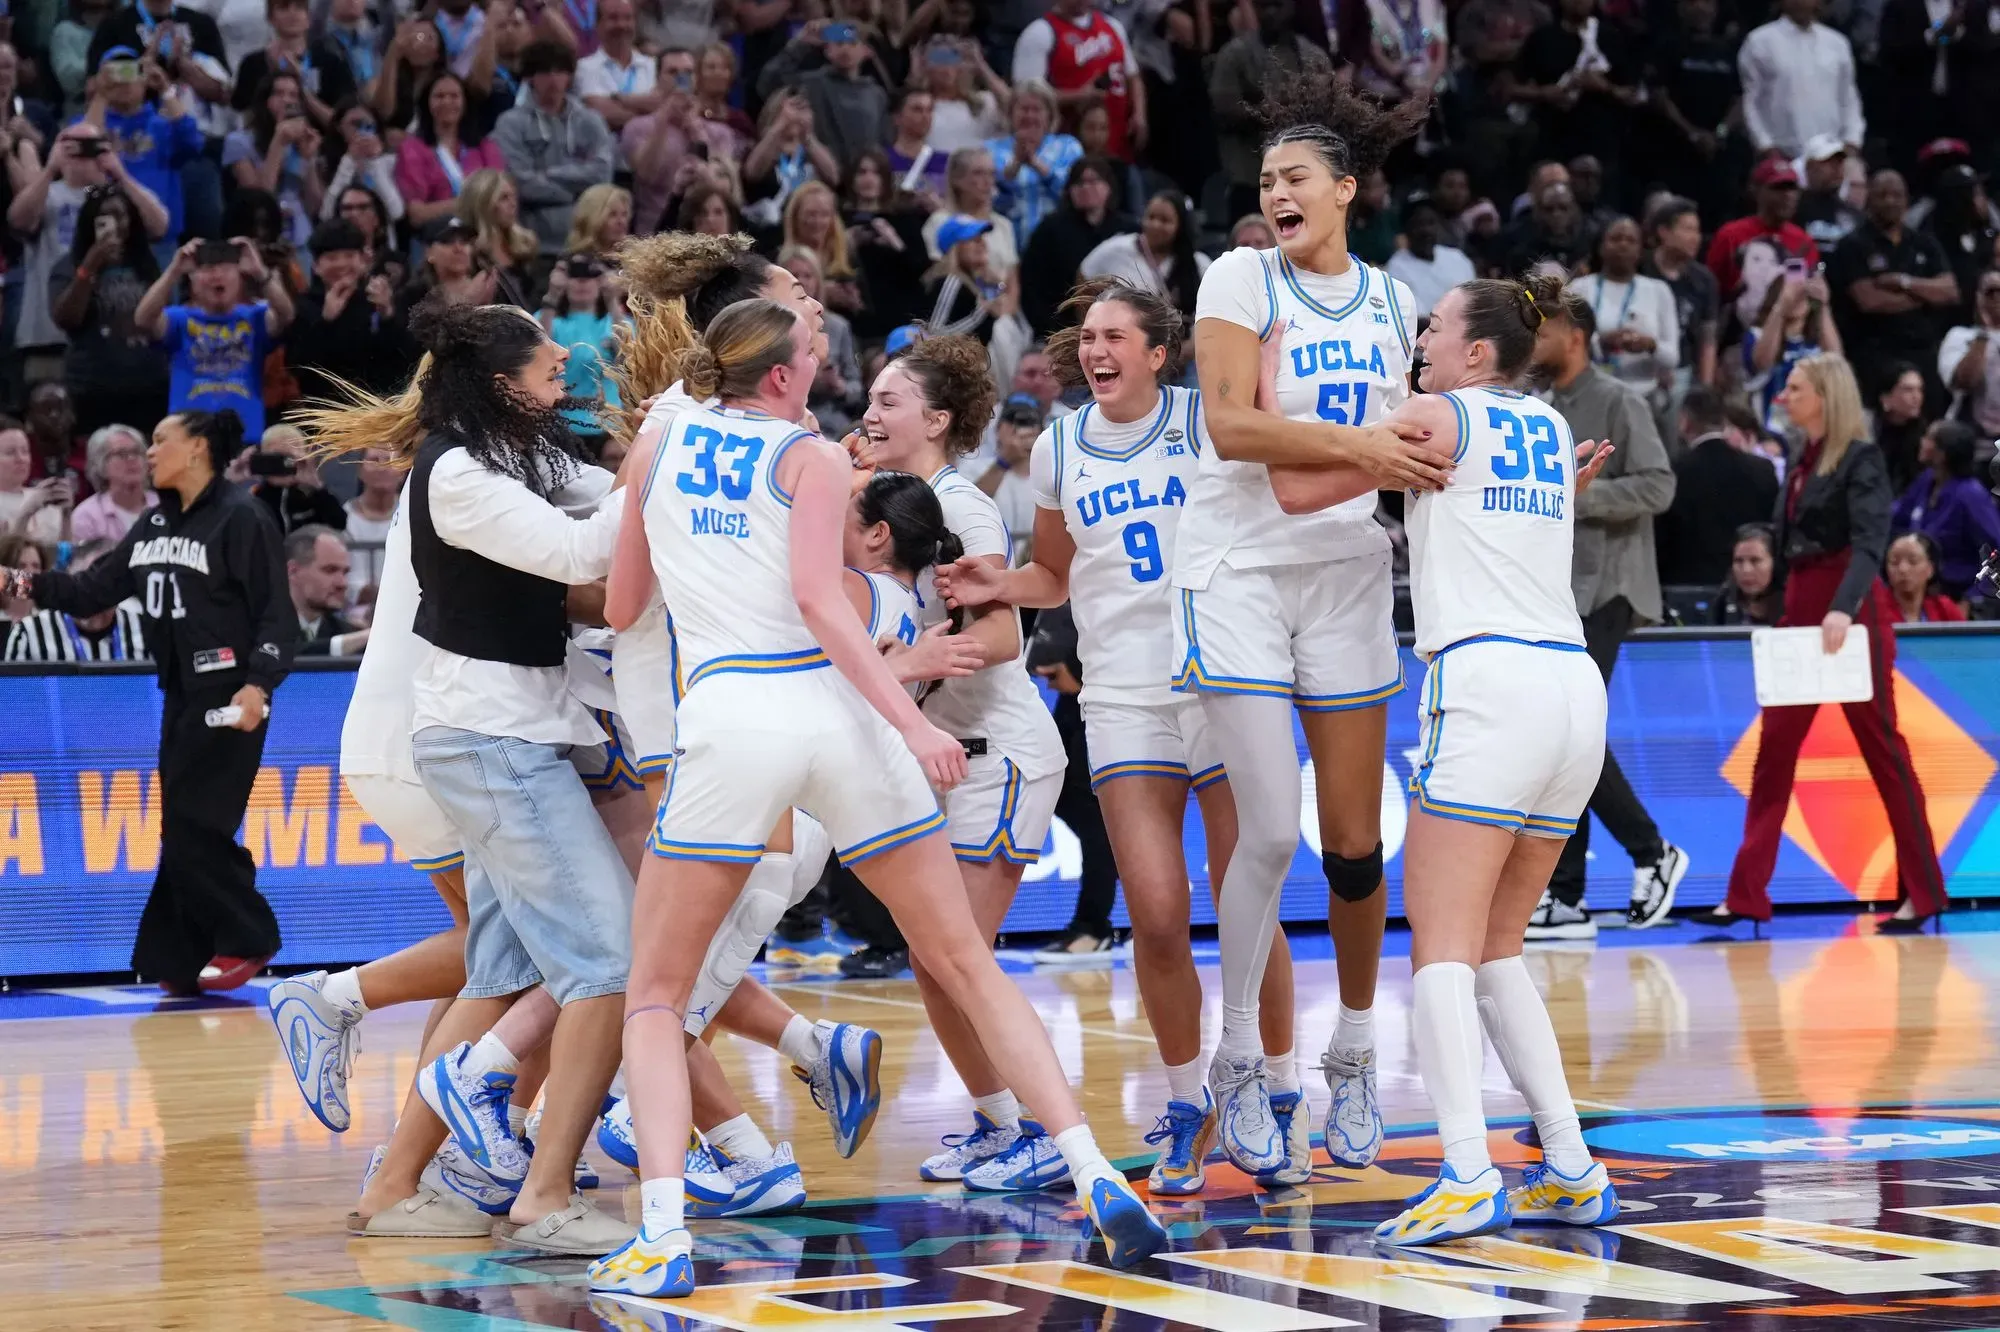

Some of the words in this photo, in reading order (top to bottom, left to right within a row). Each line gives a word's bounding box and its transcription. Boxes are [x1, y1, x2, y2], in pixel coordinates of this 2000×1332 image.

[1290, 340, 1386, 379] UCLA
[1316, 382, 1369, 427] 51
[675, 423, 765, 501] 33
[1485, 406, 1565, 486] 32
[690, 507, 750, 539] MUSE
[1076, 475, 1187, 527] UCLA
[1482, 486, 1565, 521] DUGALIĆ
[1122, 520, 1164, 583] 9
[146, 571, 187, 619] 01
